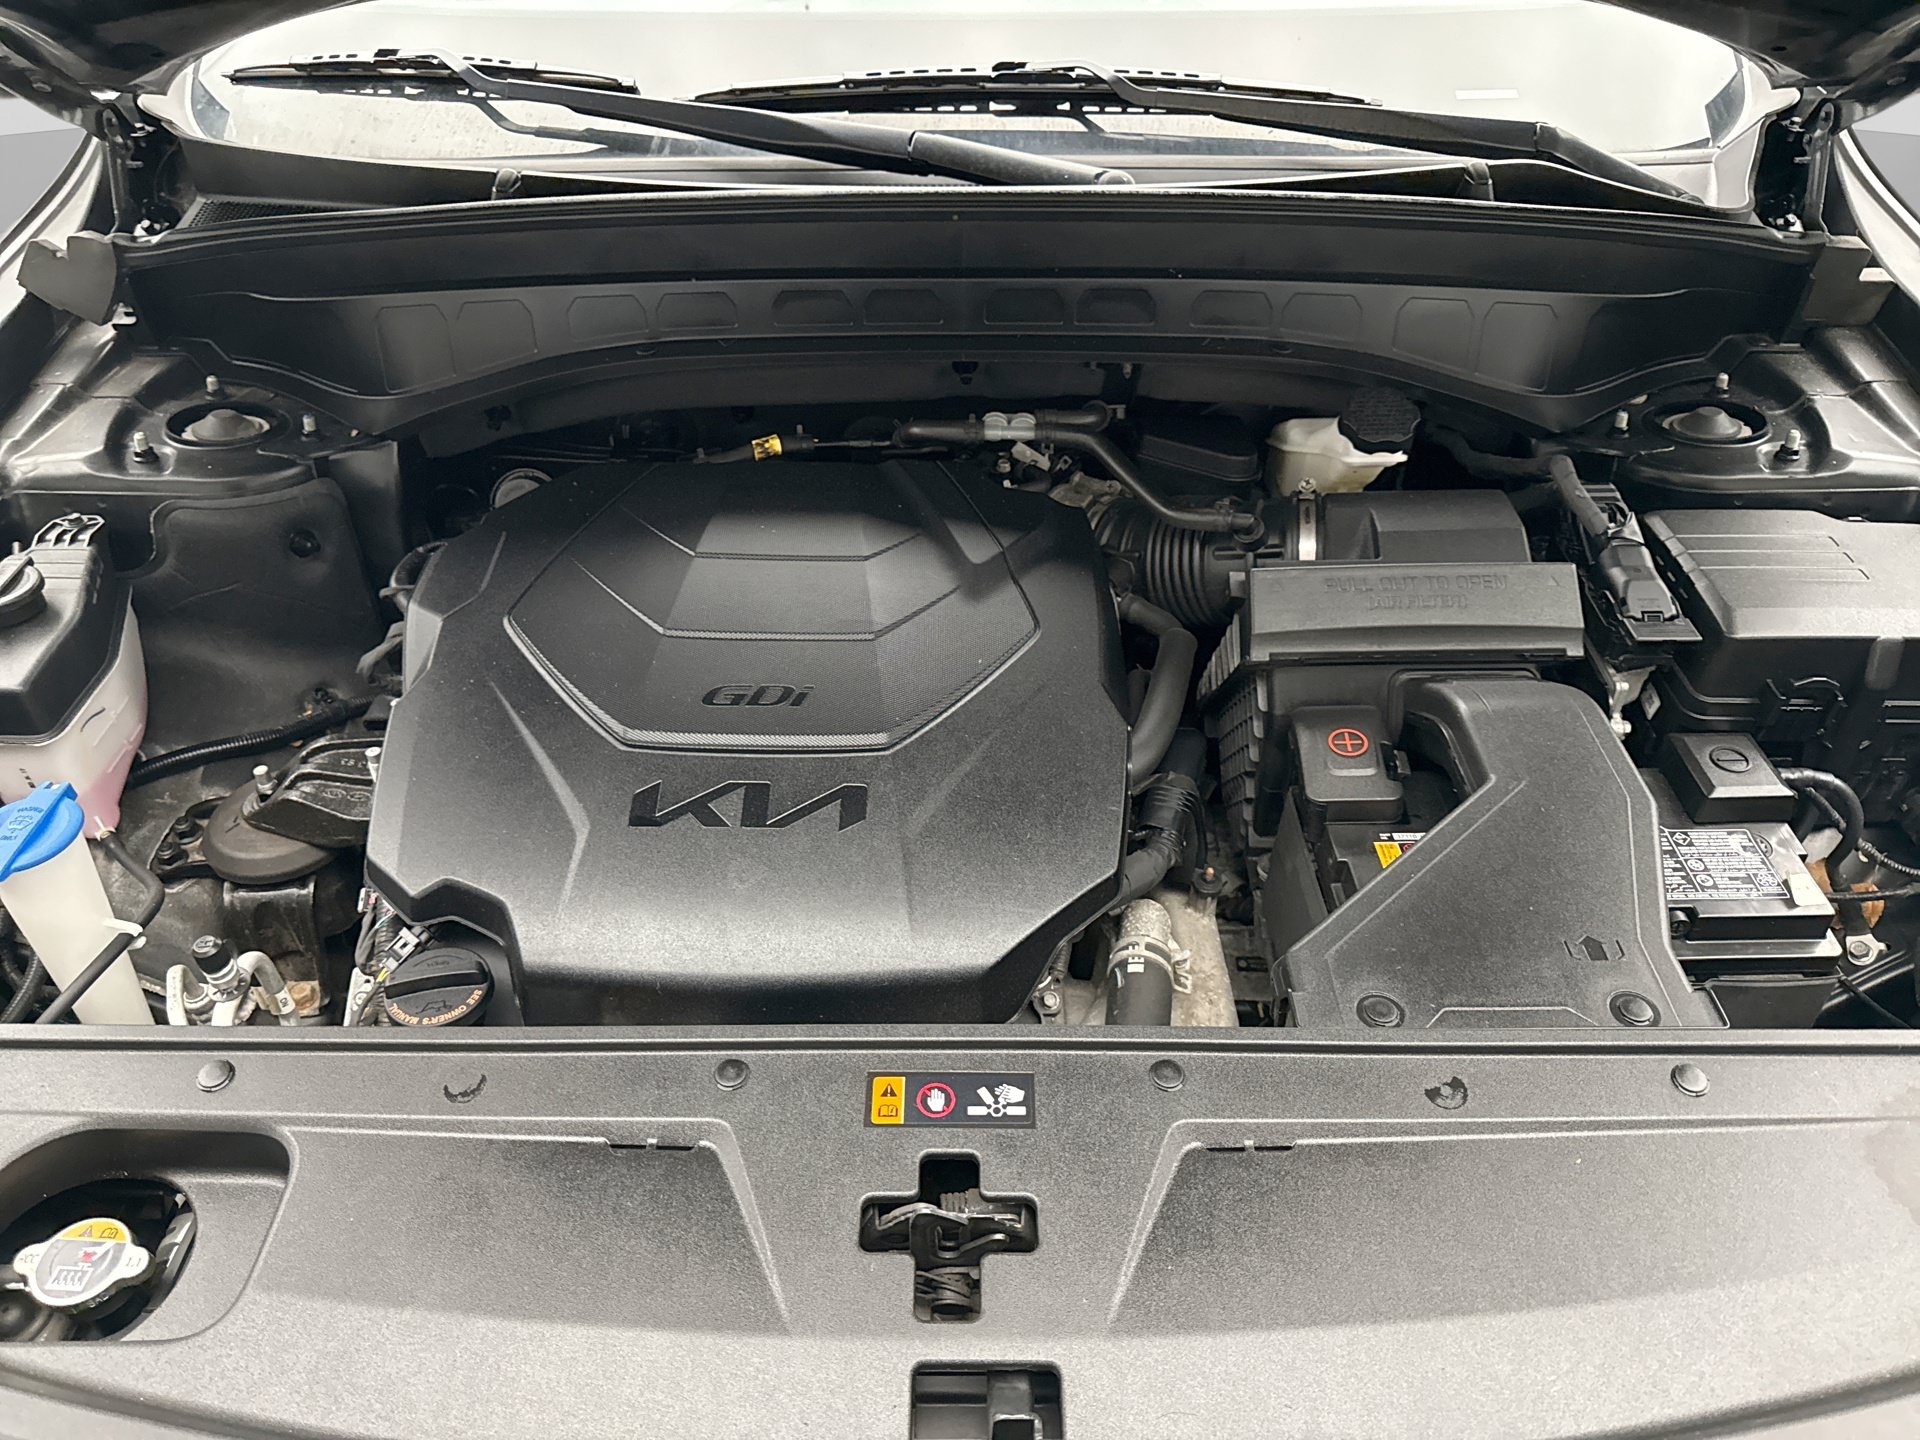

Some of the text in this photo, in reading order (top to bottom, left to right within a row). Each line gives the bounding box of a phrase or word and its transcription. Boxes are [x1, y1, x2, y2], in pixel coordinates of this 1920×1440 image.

[1323, 574, 1508, 593] PULL OUT TO OPEN
[701, 684, 815, 708] GDi
[628, 779, 868, 832] KIA
[388, 988, 483, 1025] SEE OWNER'S MANUAL
